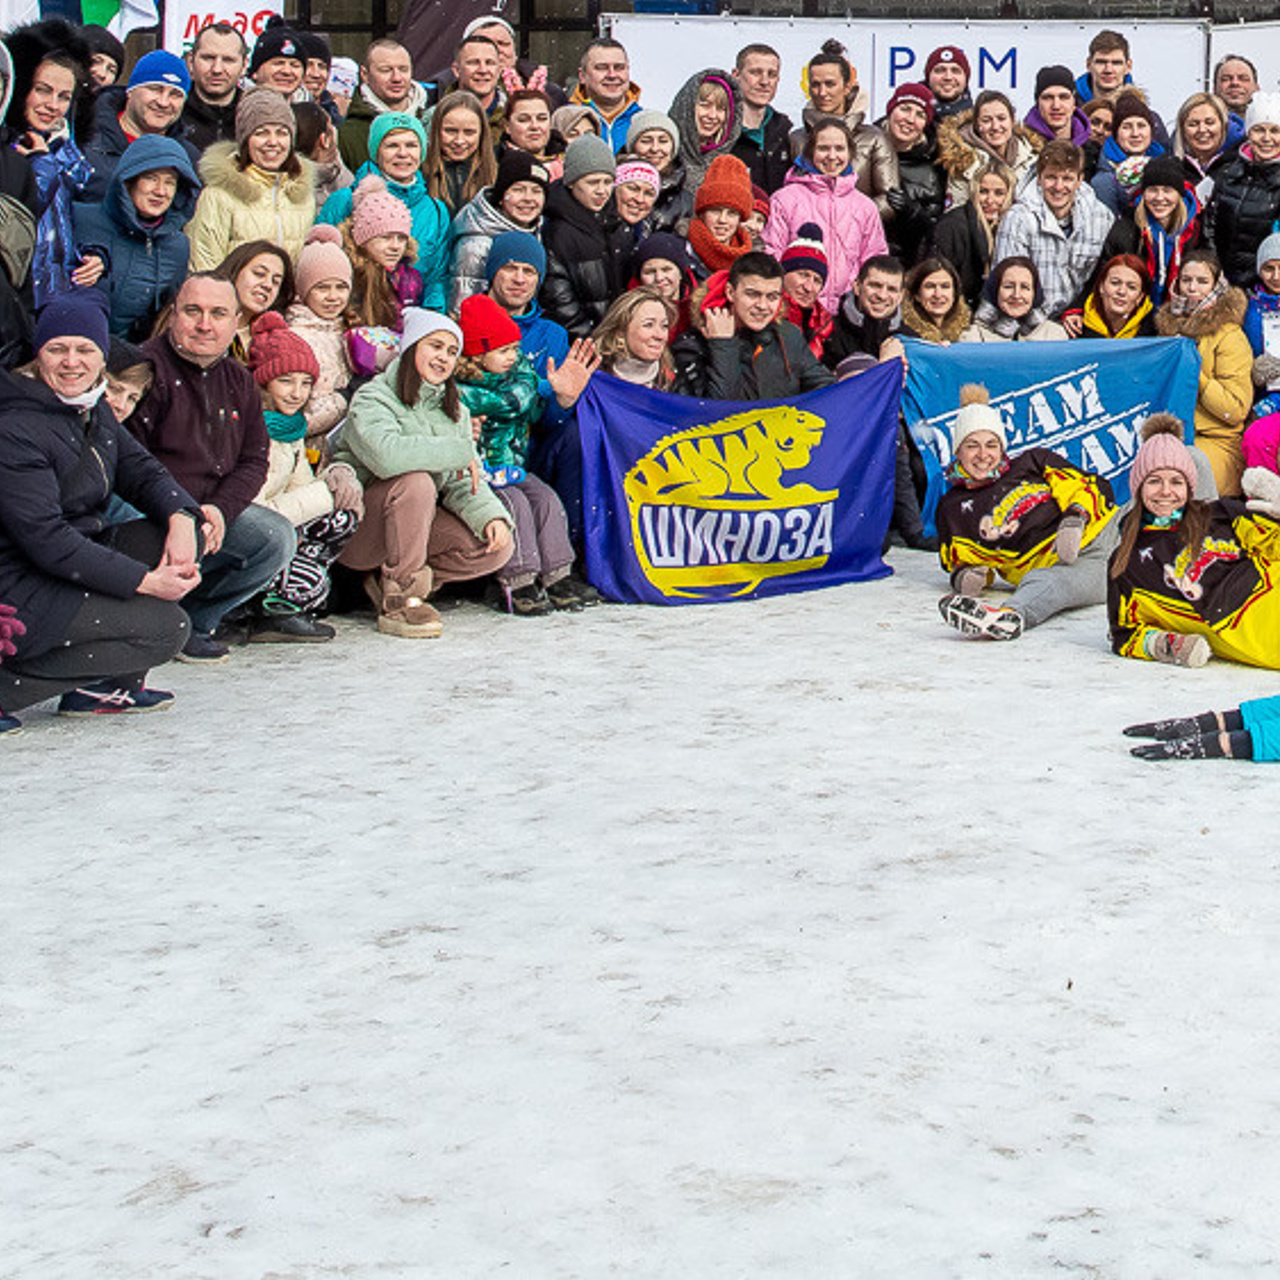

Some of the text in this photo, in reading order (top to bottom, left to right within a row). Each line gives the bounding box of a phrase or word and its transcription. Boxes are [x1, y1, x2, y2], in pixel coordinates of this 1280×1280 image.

[889, 46, 1017, 89] РМ
[917, 371, 1105, 468] DEAM
[642, 502, 833, 567] ШИНОЗА
